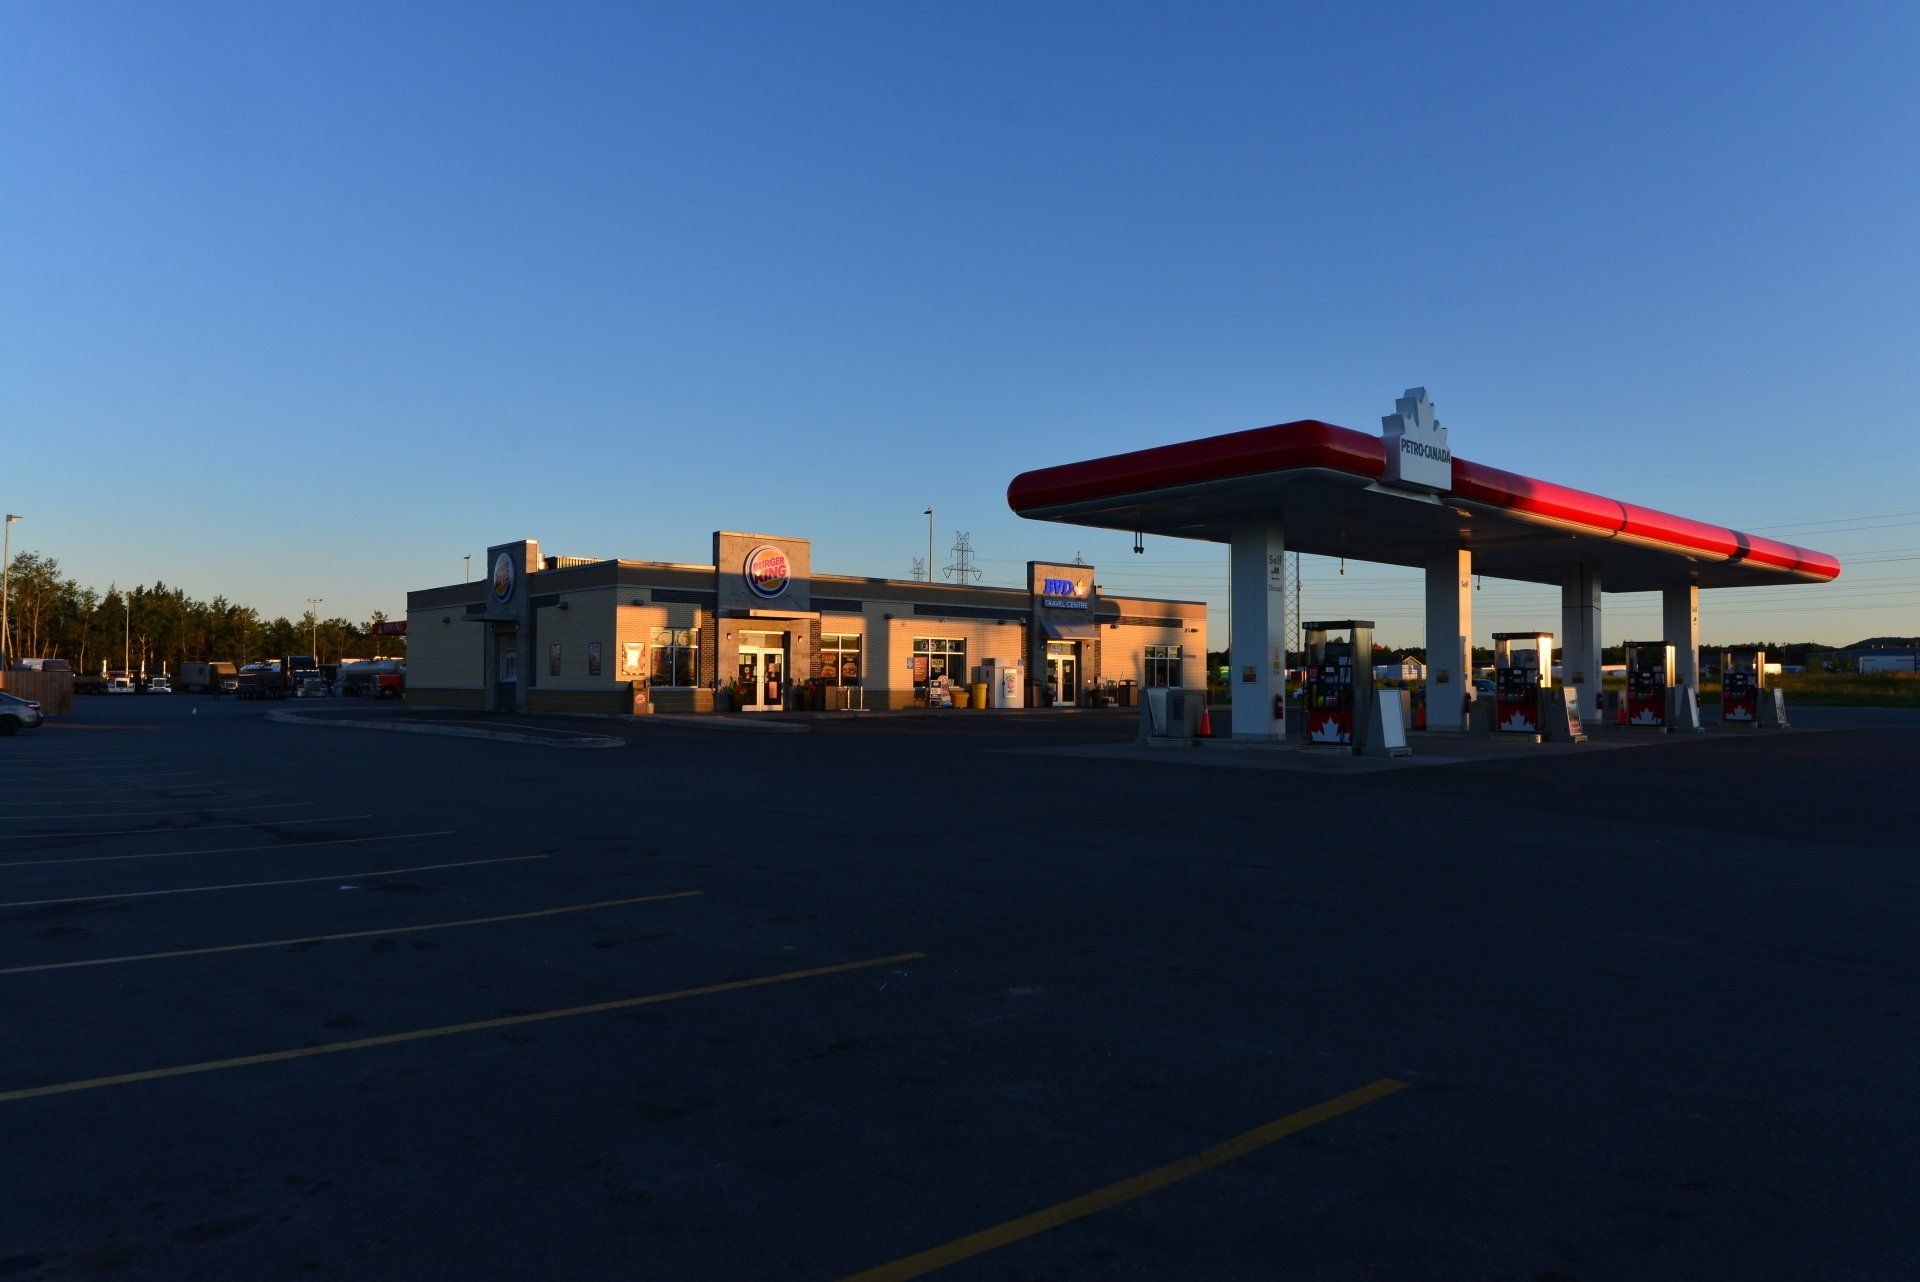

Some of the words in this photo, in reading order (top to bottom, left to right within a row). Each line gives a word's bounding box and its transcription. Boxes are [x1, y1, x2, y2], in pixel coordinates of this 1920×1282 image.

[753, 556, 785, 570] BURGER
[1269, 554, 1283, 565] Self
[754, 565, 787, 585] KING
[1043, 579, 1075, 595] BVD
[1044, 600, 1066, 608] TRAVEL
[1066, 601, 1088, 609] CENTRE
